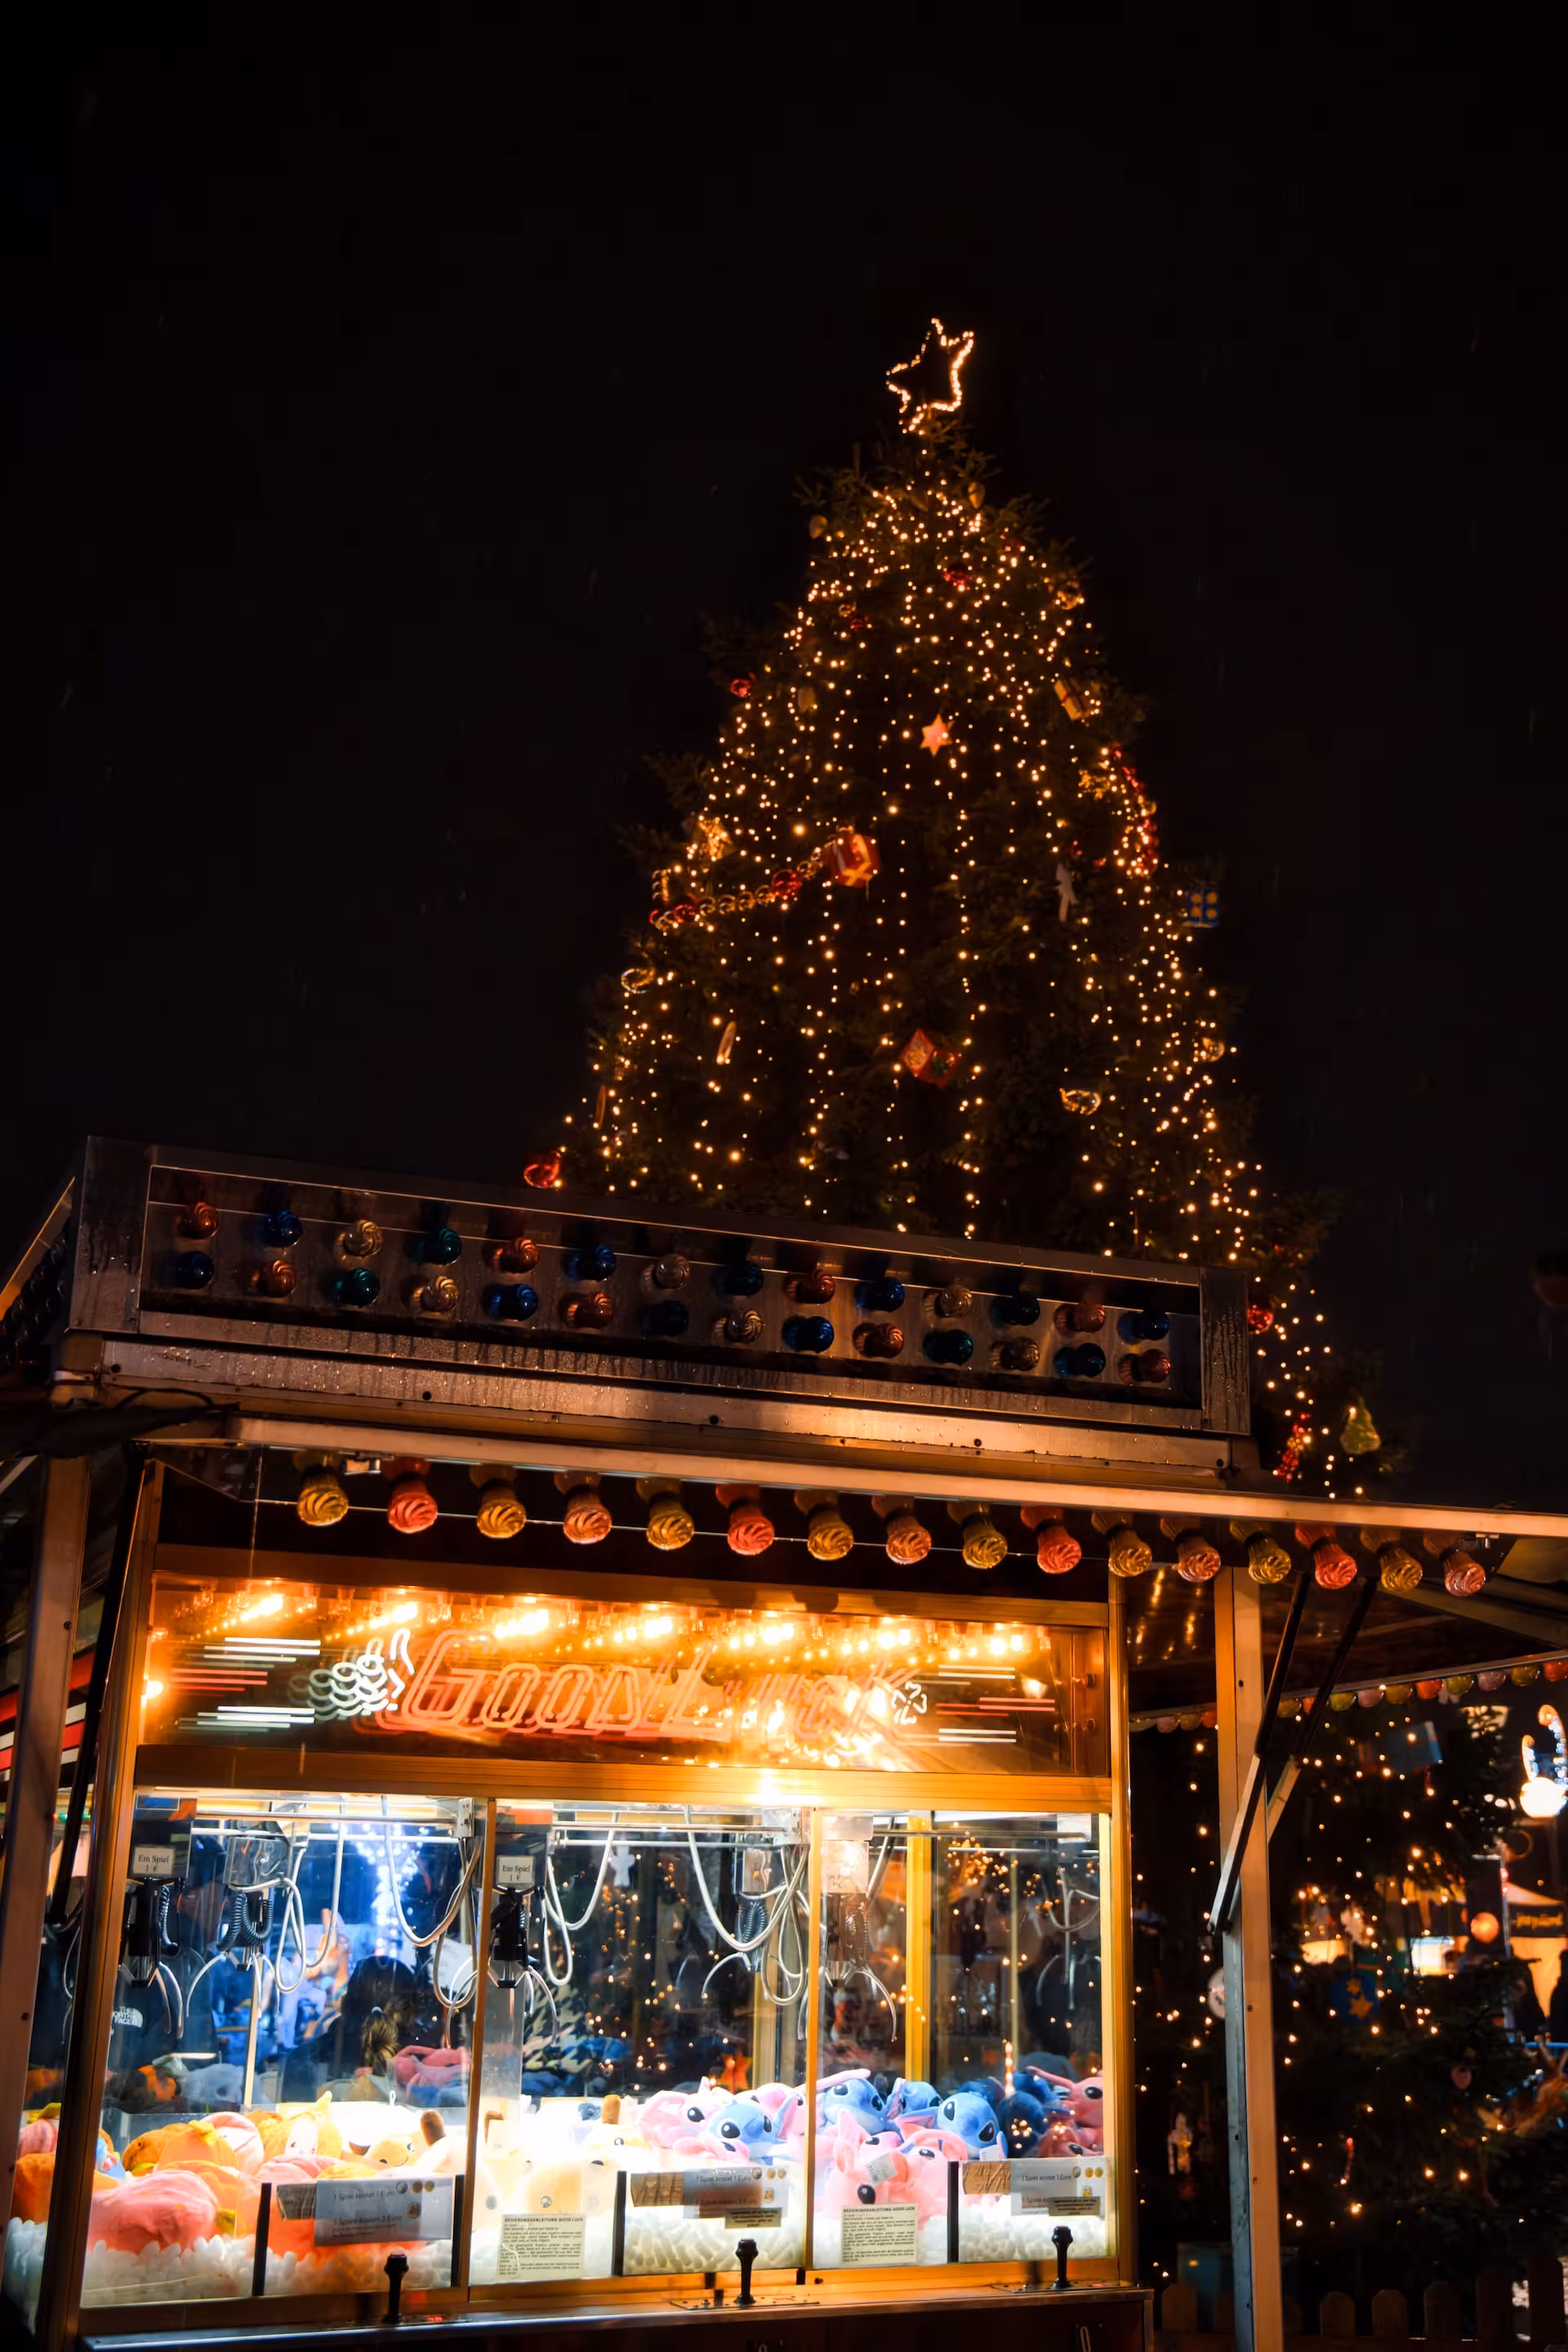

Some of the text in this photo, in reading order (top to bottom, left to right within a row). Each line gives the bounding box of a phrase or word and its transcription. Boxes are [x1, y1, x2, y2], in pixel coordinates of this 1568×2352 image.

[401, 1629, 640, 1731] GOOD
[151, 1855, 169, 1864] Spiel
[514, 1864, 531, 1873] Spiel
